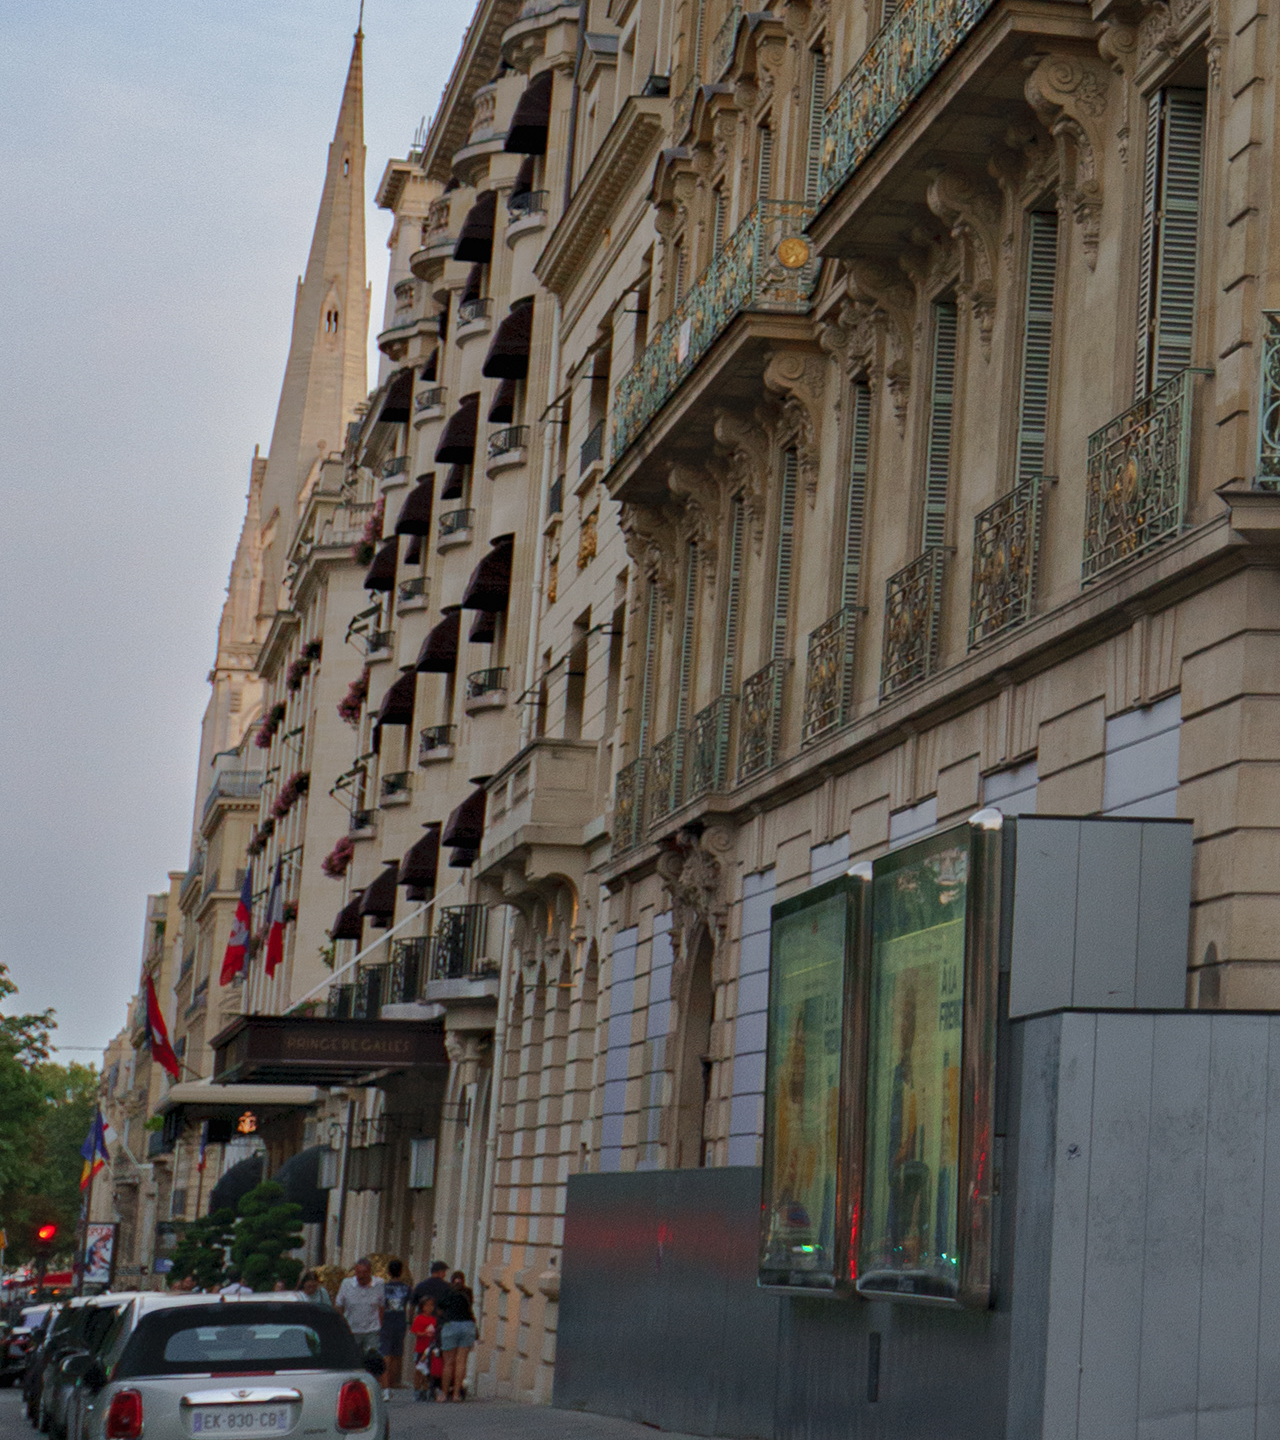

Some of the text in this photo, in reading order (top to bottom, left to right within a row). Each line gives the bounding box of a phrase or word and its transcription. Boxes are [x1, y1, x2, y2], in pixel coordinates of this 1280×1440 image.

[286, 1036, 411, 1053] PRINCE DE GALLES
